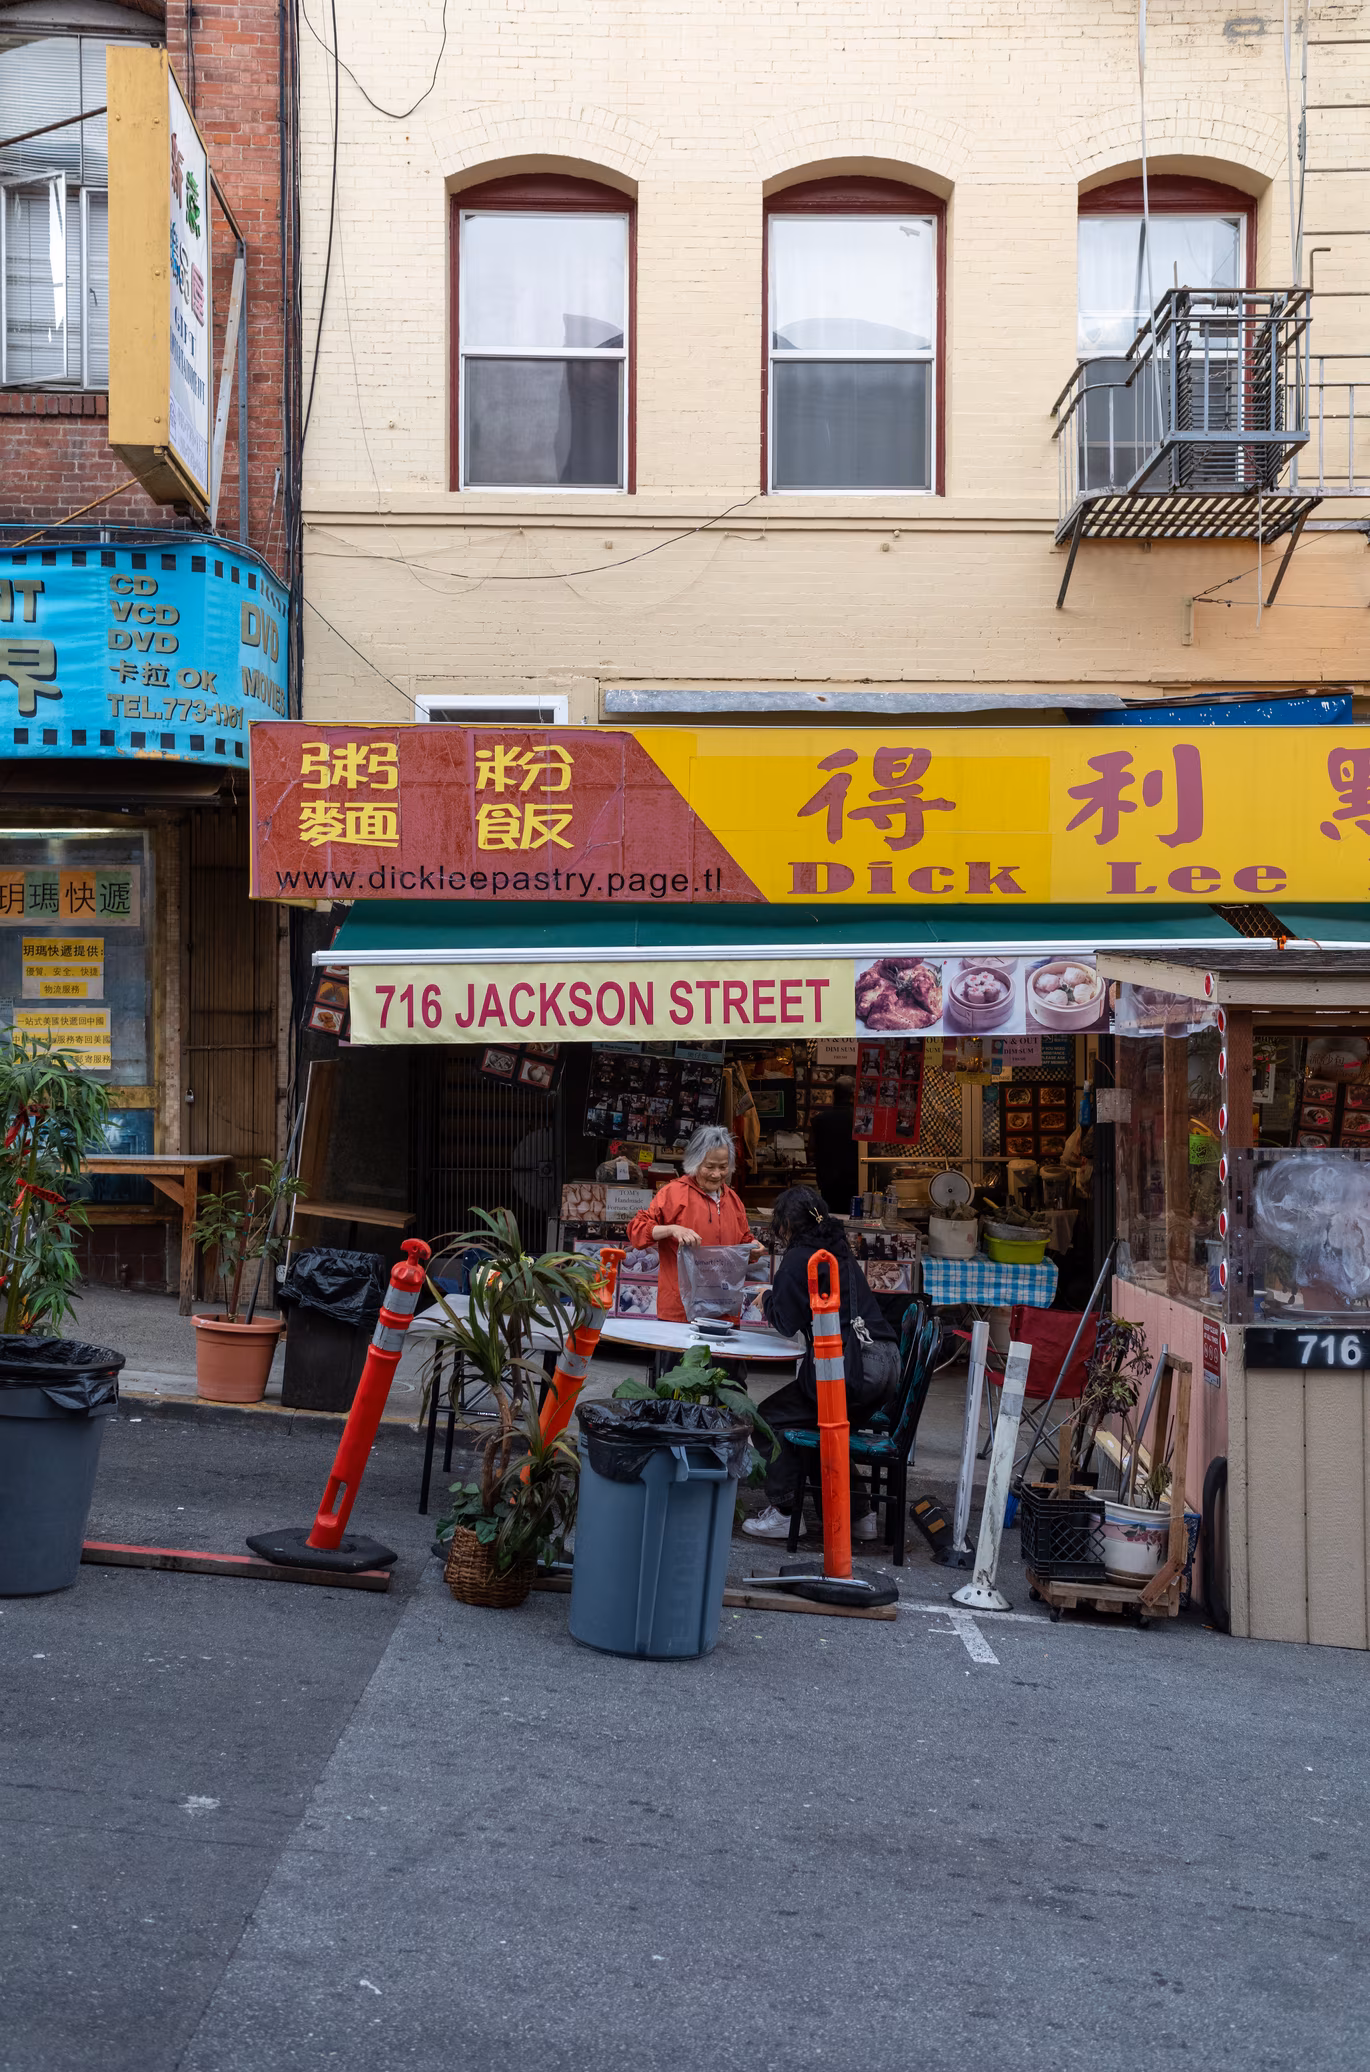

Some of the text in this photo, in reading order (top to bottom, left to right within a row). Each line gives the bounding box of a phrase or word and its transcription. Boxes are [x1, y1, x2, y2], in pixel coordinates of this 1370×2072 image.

[109, 573, 158, 596] CD
[109, 600, 180, 626] VCD
[108, 628, 180, 654] DVD
[241, 600, 279, 664] DVD
[241, 665, 285, 717] MOVIES
[276, 863, 722, 899] www.dickleepastry.page.tl
[787, 861, 1288, 895] Dick Lee
[385, 978, 830, 1029] 716 JACKSON STREET
[1297, 1335, 1363, 1366] 716
